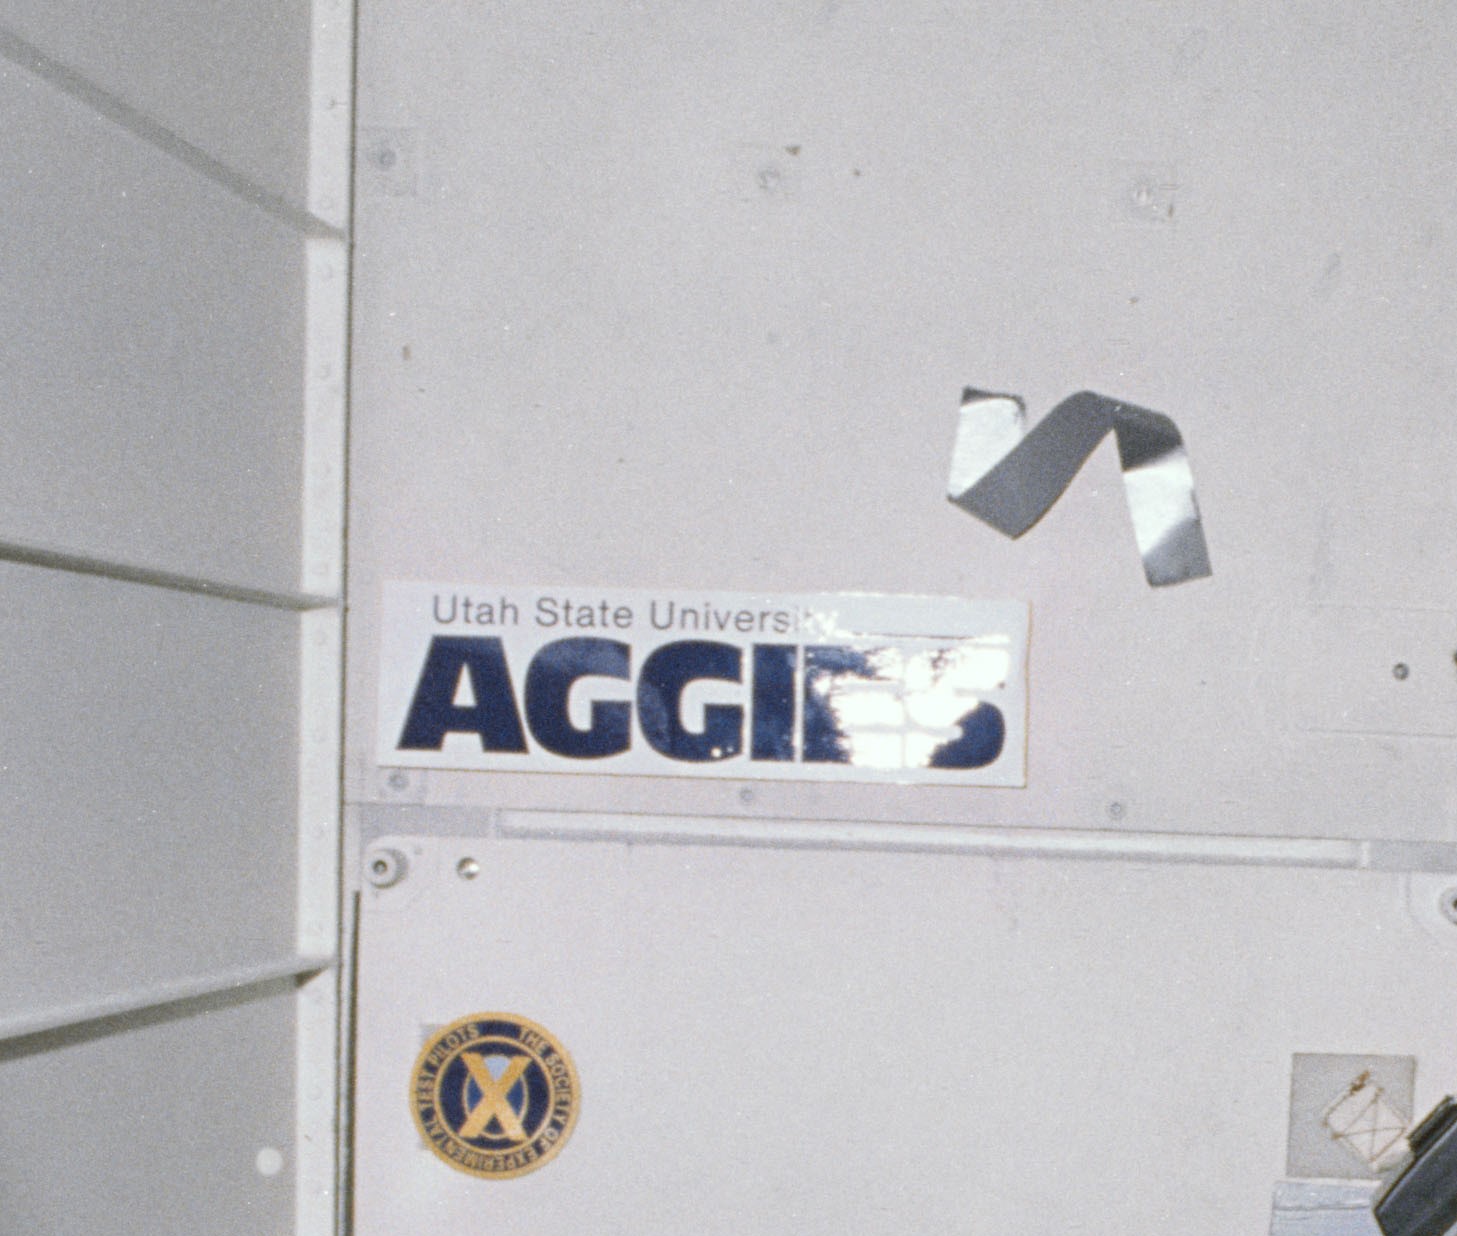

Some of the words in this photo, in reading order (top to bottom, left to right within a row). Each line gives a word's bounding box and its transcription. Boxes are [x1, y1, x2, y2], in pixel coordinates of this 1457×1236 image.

[432, 594, 519, 625] Utah
[535, 597, 634, 629] State
[428, 1023, 481, 1068] PILOTS
[519, 1026, 549, 1055] THE
[417, 1071, 435, 1111] TEST
[544, 1053, 572, 1125] SOCIETY
[424, 1119, 539, 1172] EXPERIMENTAL
[538, 1127, 560, 1152] OF
